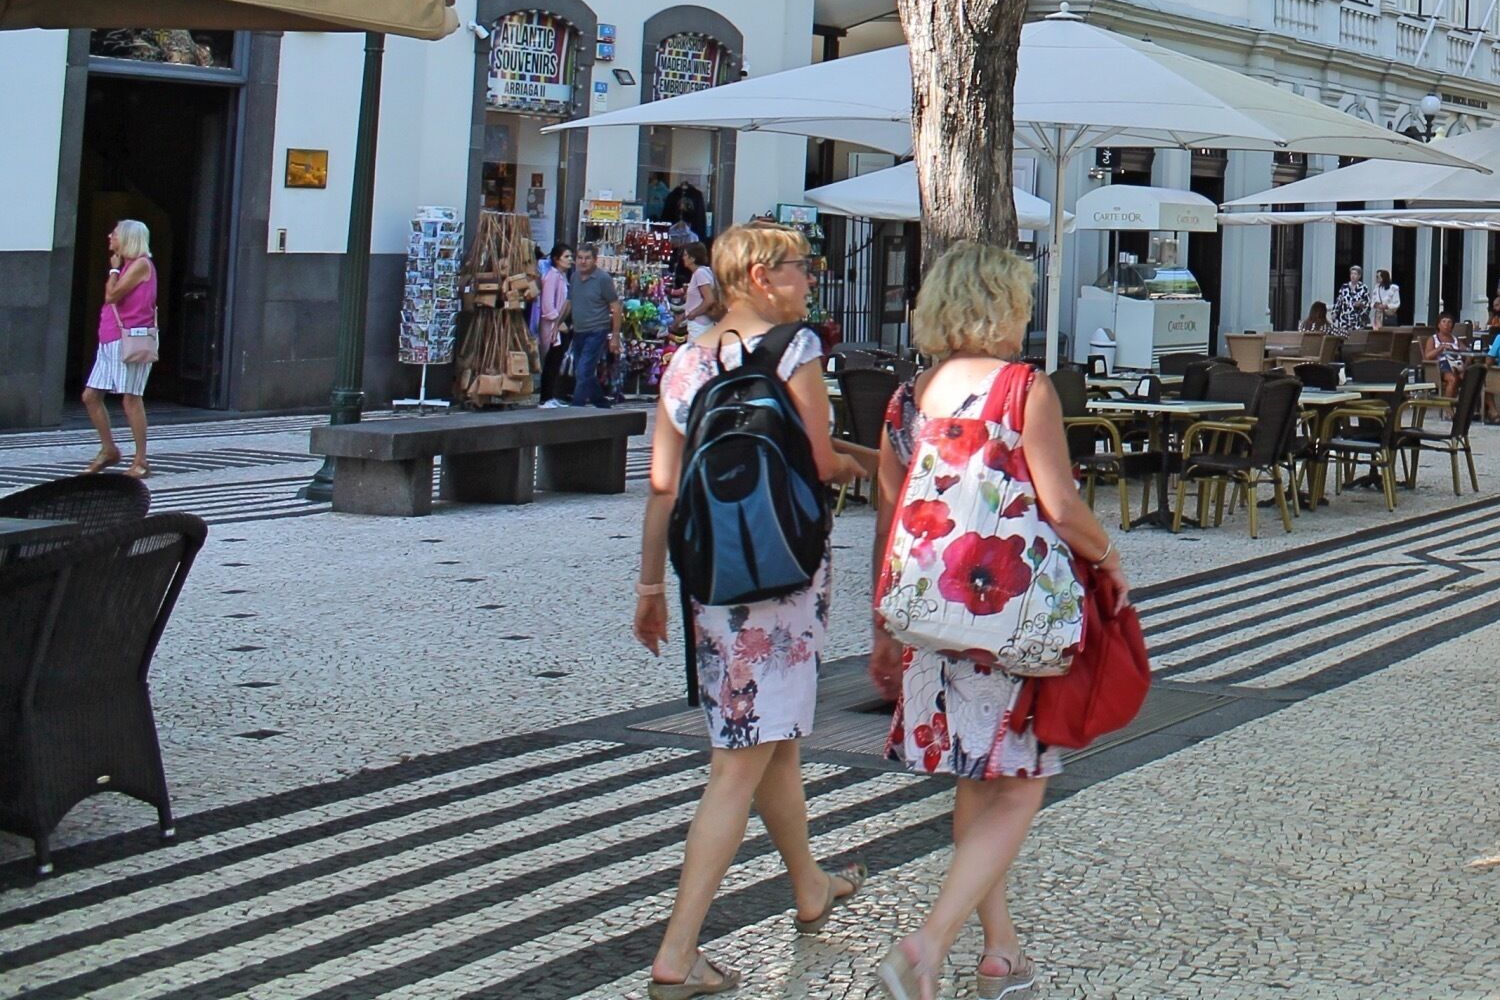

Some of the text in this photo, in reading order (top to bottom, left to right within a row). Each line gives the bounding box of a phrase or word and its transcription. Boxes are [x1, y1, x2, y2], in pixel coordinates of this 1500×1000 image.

[501, 22, 555, 50] ATLANTIC
[495, 48, 557, 75] SOUVENIRS
[660, 55, 711, 76] MADEIRA WINE
[504, 81, 538, 97] ARRIAGA
[1093, 211, 1118, 222] CARTE
